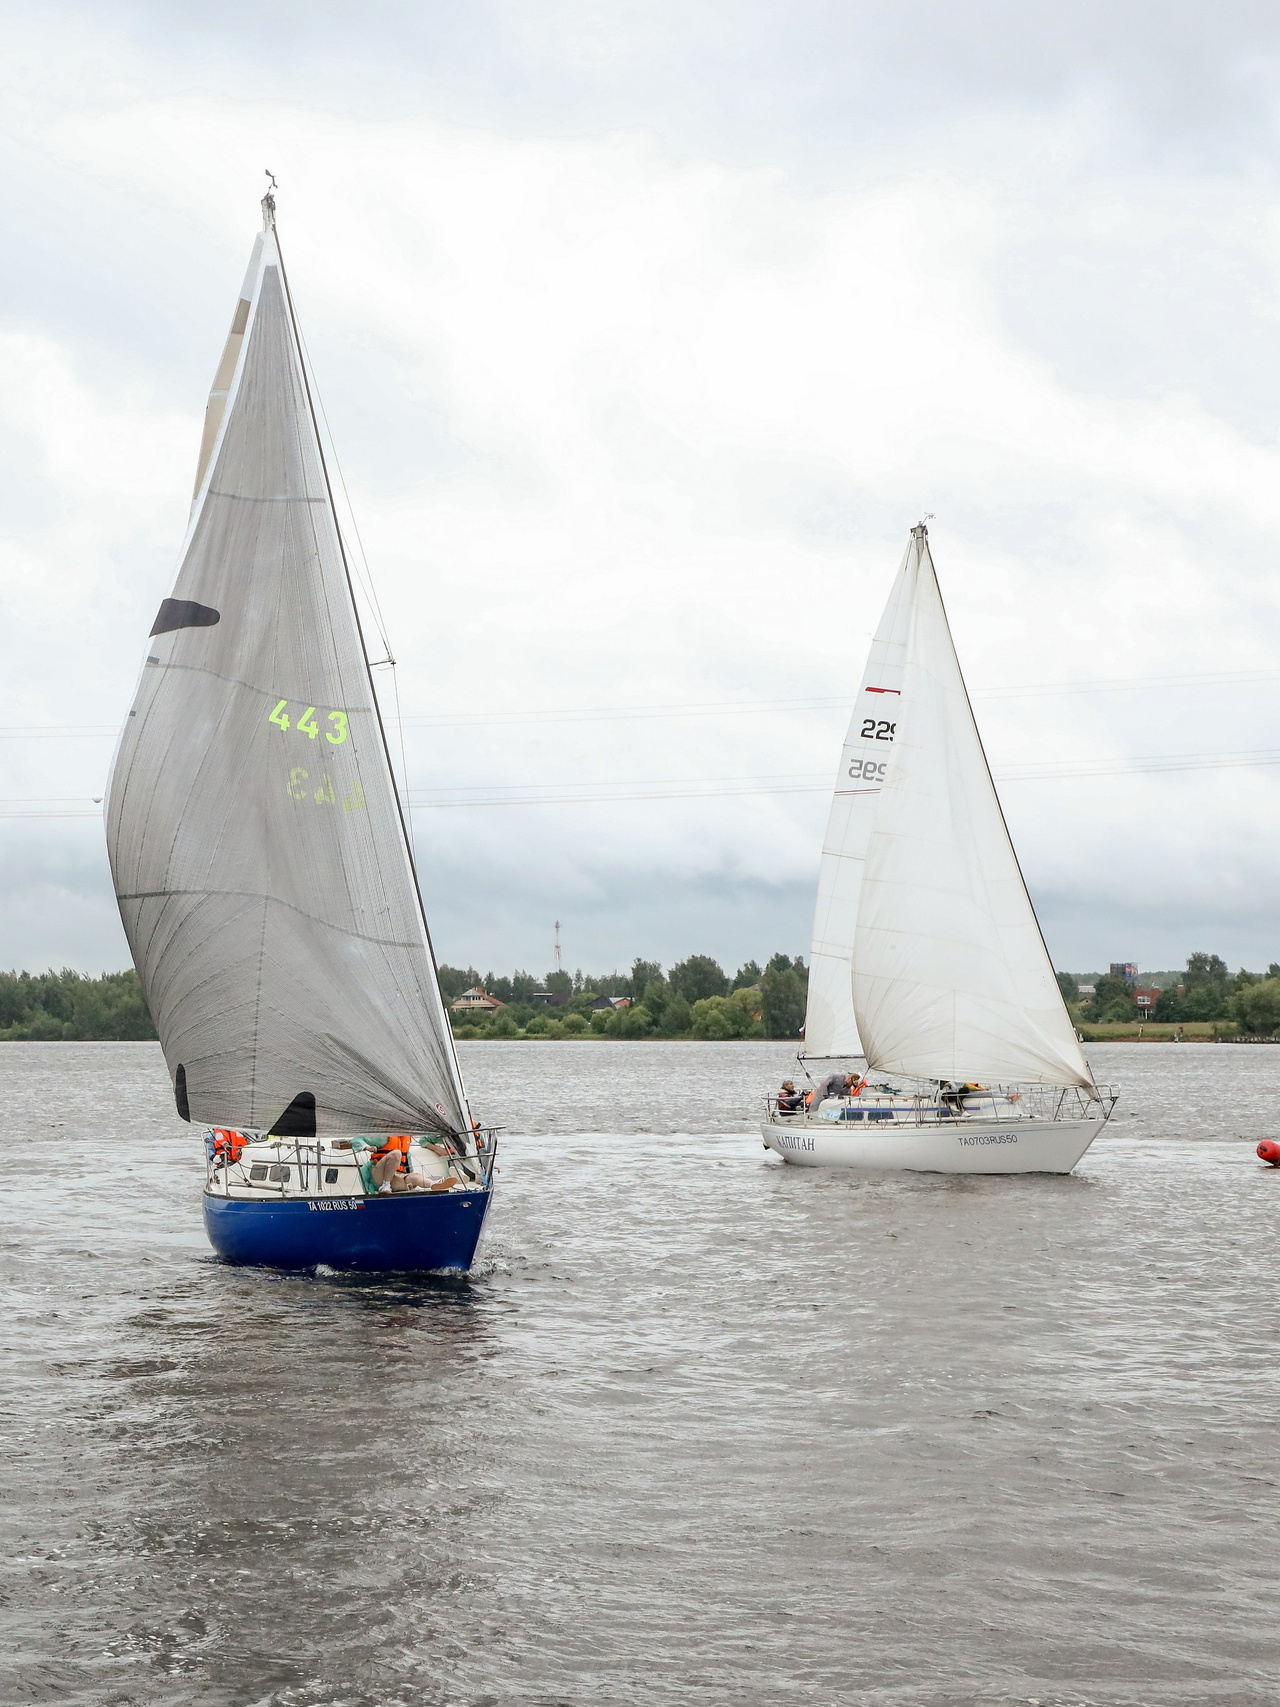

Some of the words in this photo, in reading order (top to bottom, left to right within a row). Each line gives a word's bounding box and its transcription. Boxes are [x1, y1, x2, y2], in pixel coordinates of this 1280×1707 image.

[268, 699, 348, 745] 443
[958, 1135, 1018, 1146] TA0703RUS50
[332, 1201, 348, 1210] RUS
